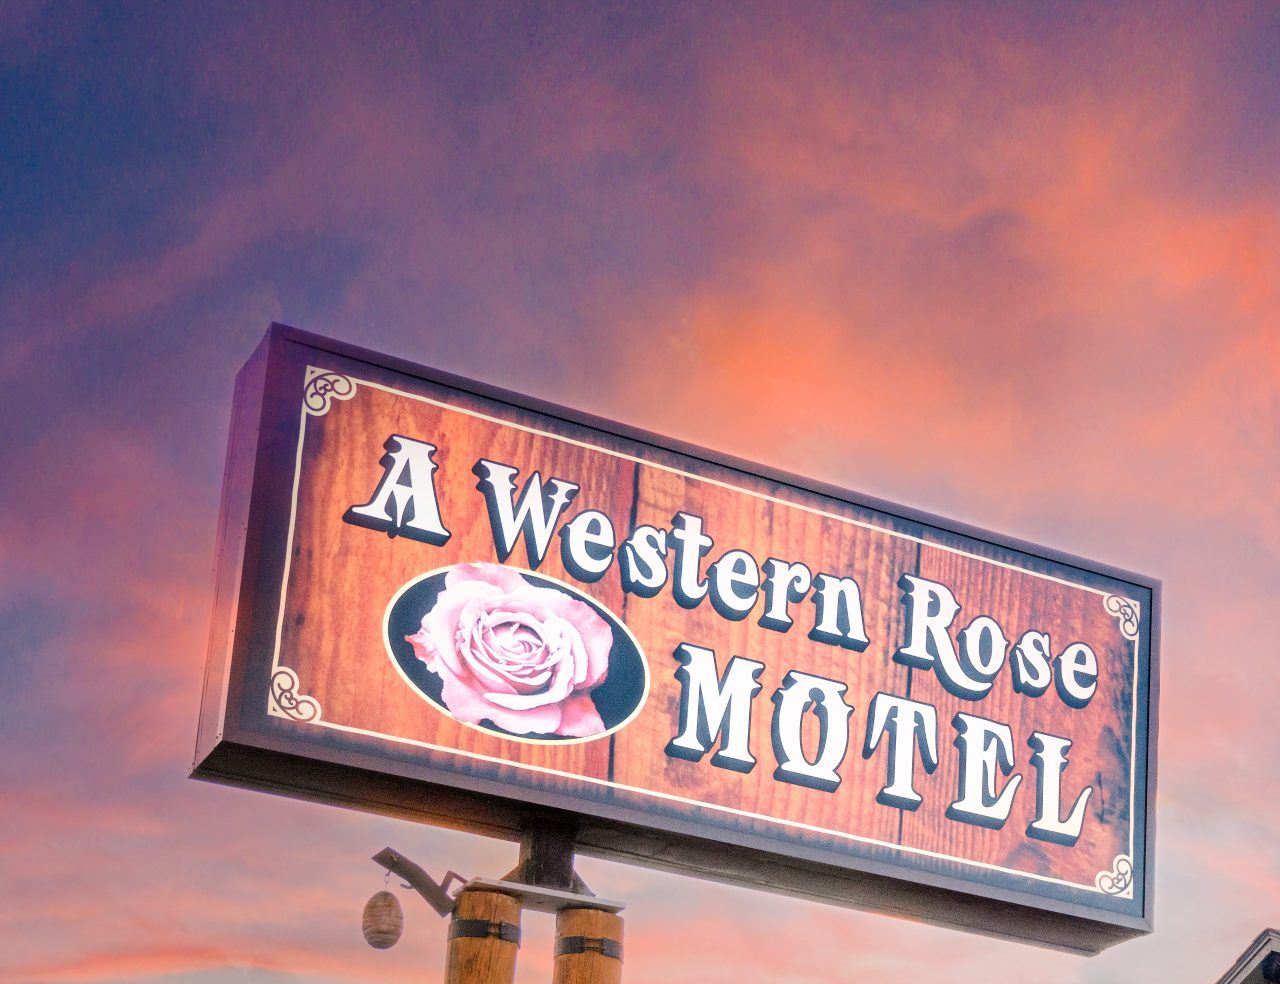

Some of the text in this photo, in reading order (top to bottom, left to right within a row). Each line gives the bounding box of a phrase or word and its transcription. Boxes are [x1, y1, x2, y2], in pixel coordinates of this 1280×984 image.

[343, 434, 1099, 709] A Western Rose
[665, 642, 1094, 848] MOTEL
